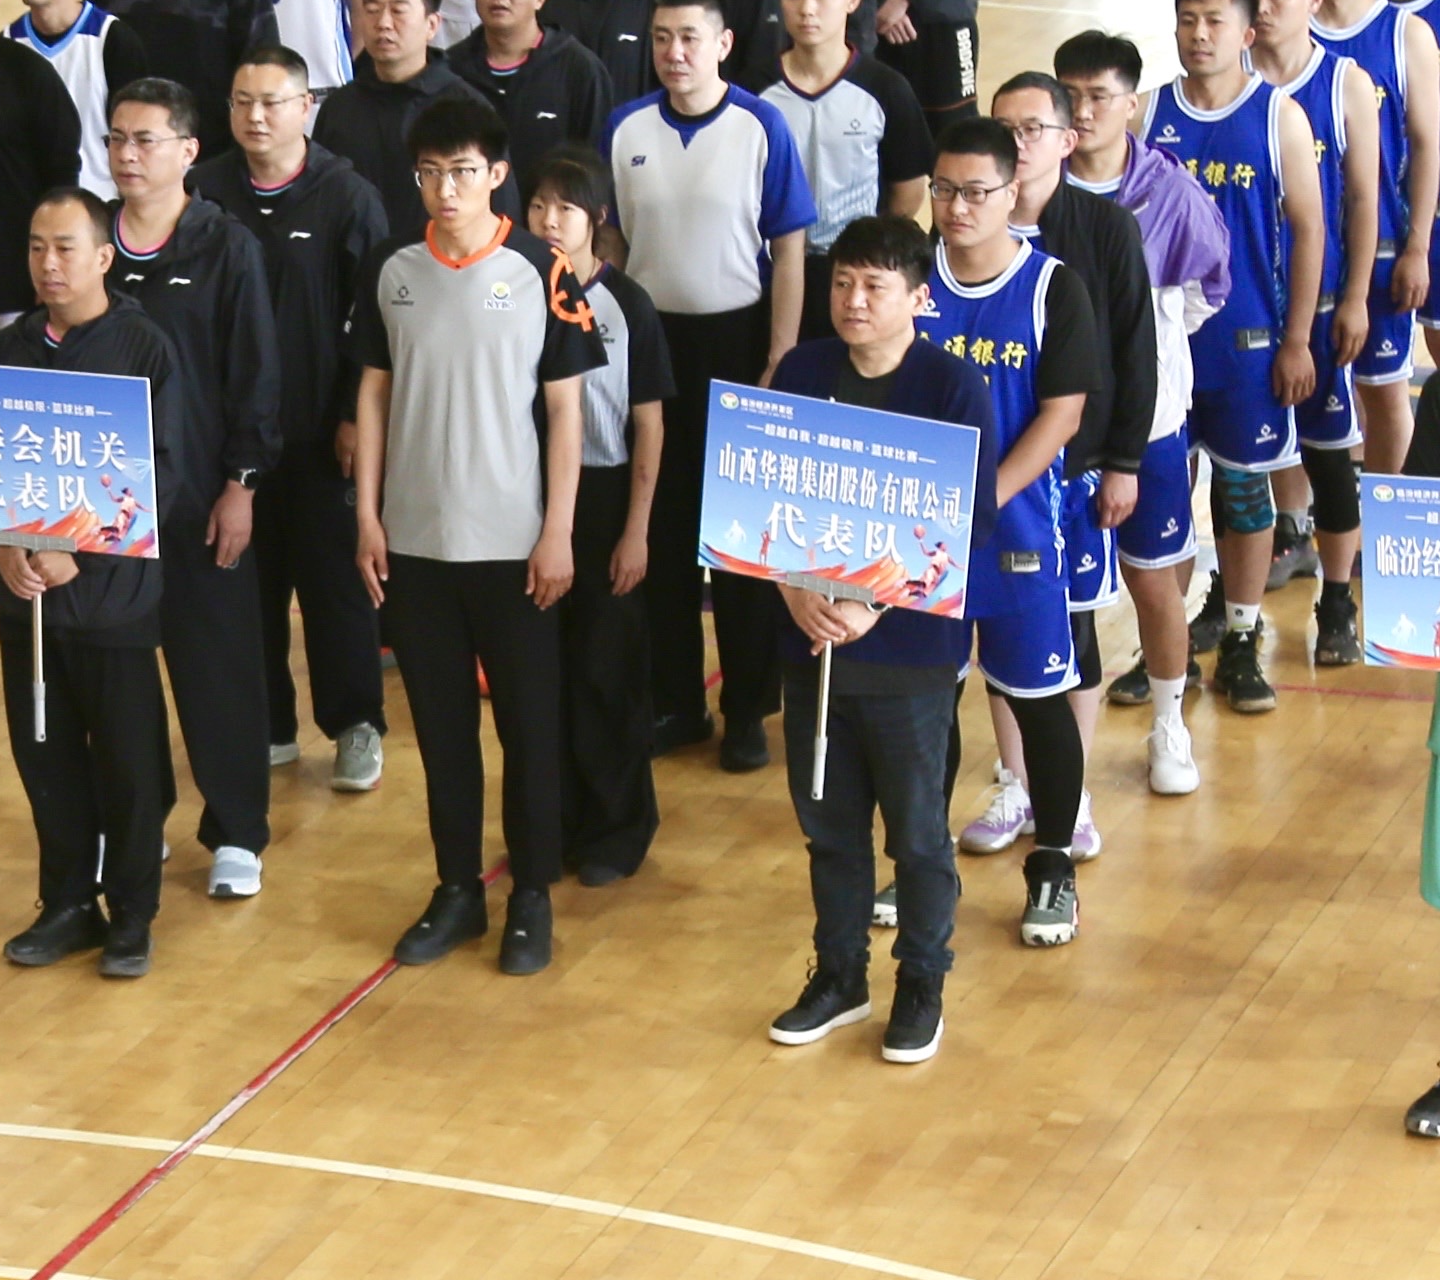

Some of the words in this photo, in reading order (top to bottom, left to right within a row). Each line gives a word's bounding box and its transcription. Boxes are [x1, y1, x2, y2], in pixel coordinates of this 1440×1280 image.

[718, 441, 962, 527] 山西华翔集团股份有限公司
[766, 501, 905, 565] 代表队
